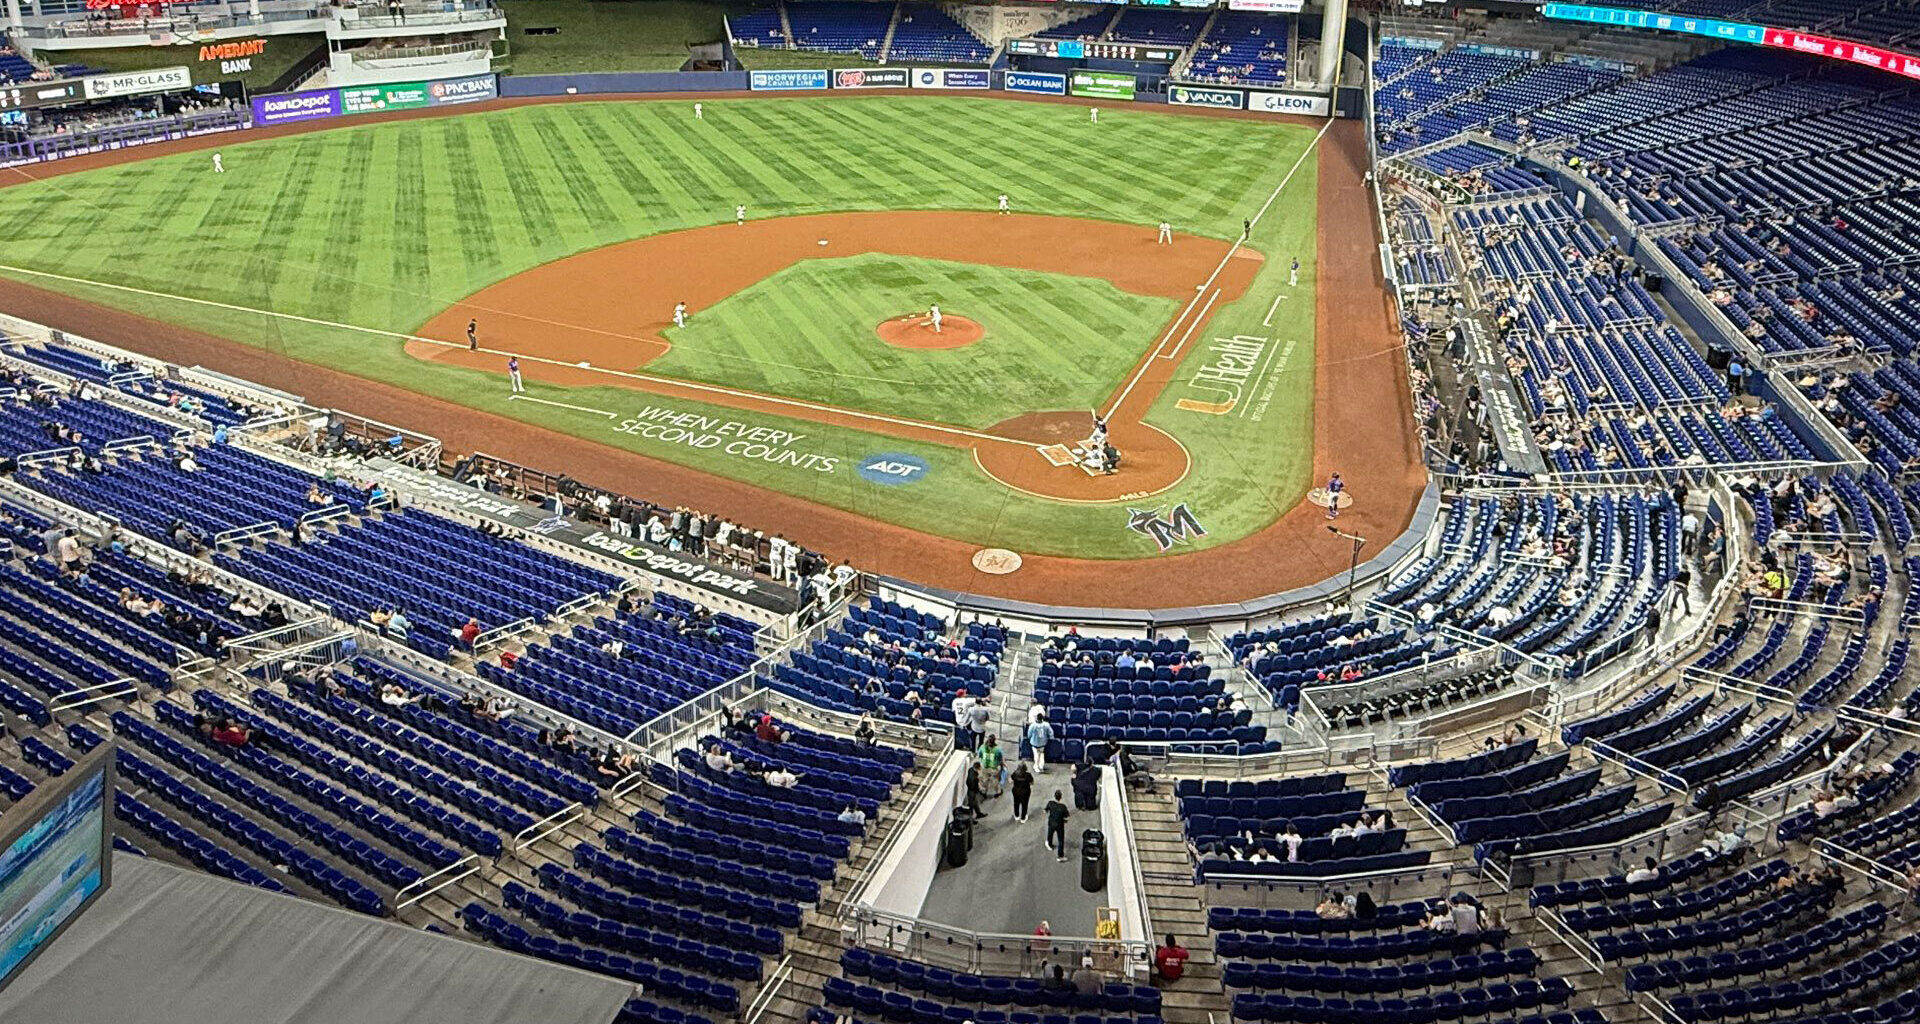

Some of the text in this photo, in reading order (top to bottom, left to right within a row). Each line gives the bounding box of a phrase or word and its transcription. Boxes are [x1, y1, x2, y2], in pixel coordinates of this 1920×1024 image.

[199, 39, 268, 61] AMERANT
[221, 58, 252, 74] BANK
[768, 73, 824, 81] NORWEGIAN
[1017, 78, 1042, 88] OCEAN
[1042, 80, 1063, 89] BANK
[445, 79, 493, 95] PNC BANK
[264, 94, 331, 112] loanDepot
[1189, 92, 1234, 105] VANDA
[1278, 97, 1313, 109] LEON
[1174, 335, 1269, 416] UHealth
[636, 405, 808, 447] WHEN EVERY
[612, 418, 841, 474] SECOND COUNTS.
[864, 459, 922, 478] ADT
[581, 531, 758, 596] loanDepot park
